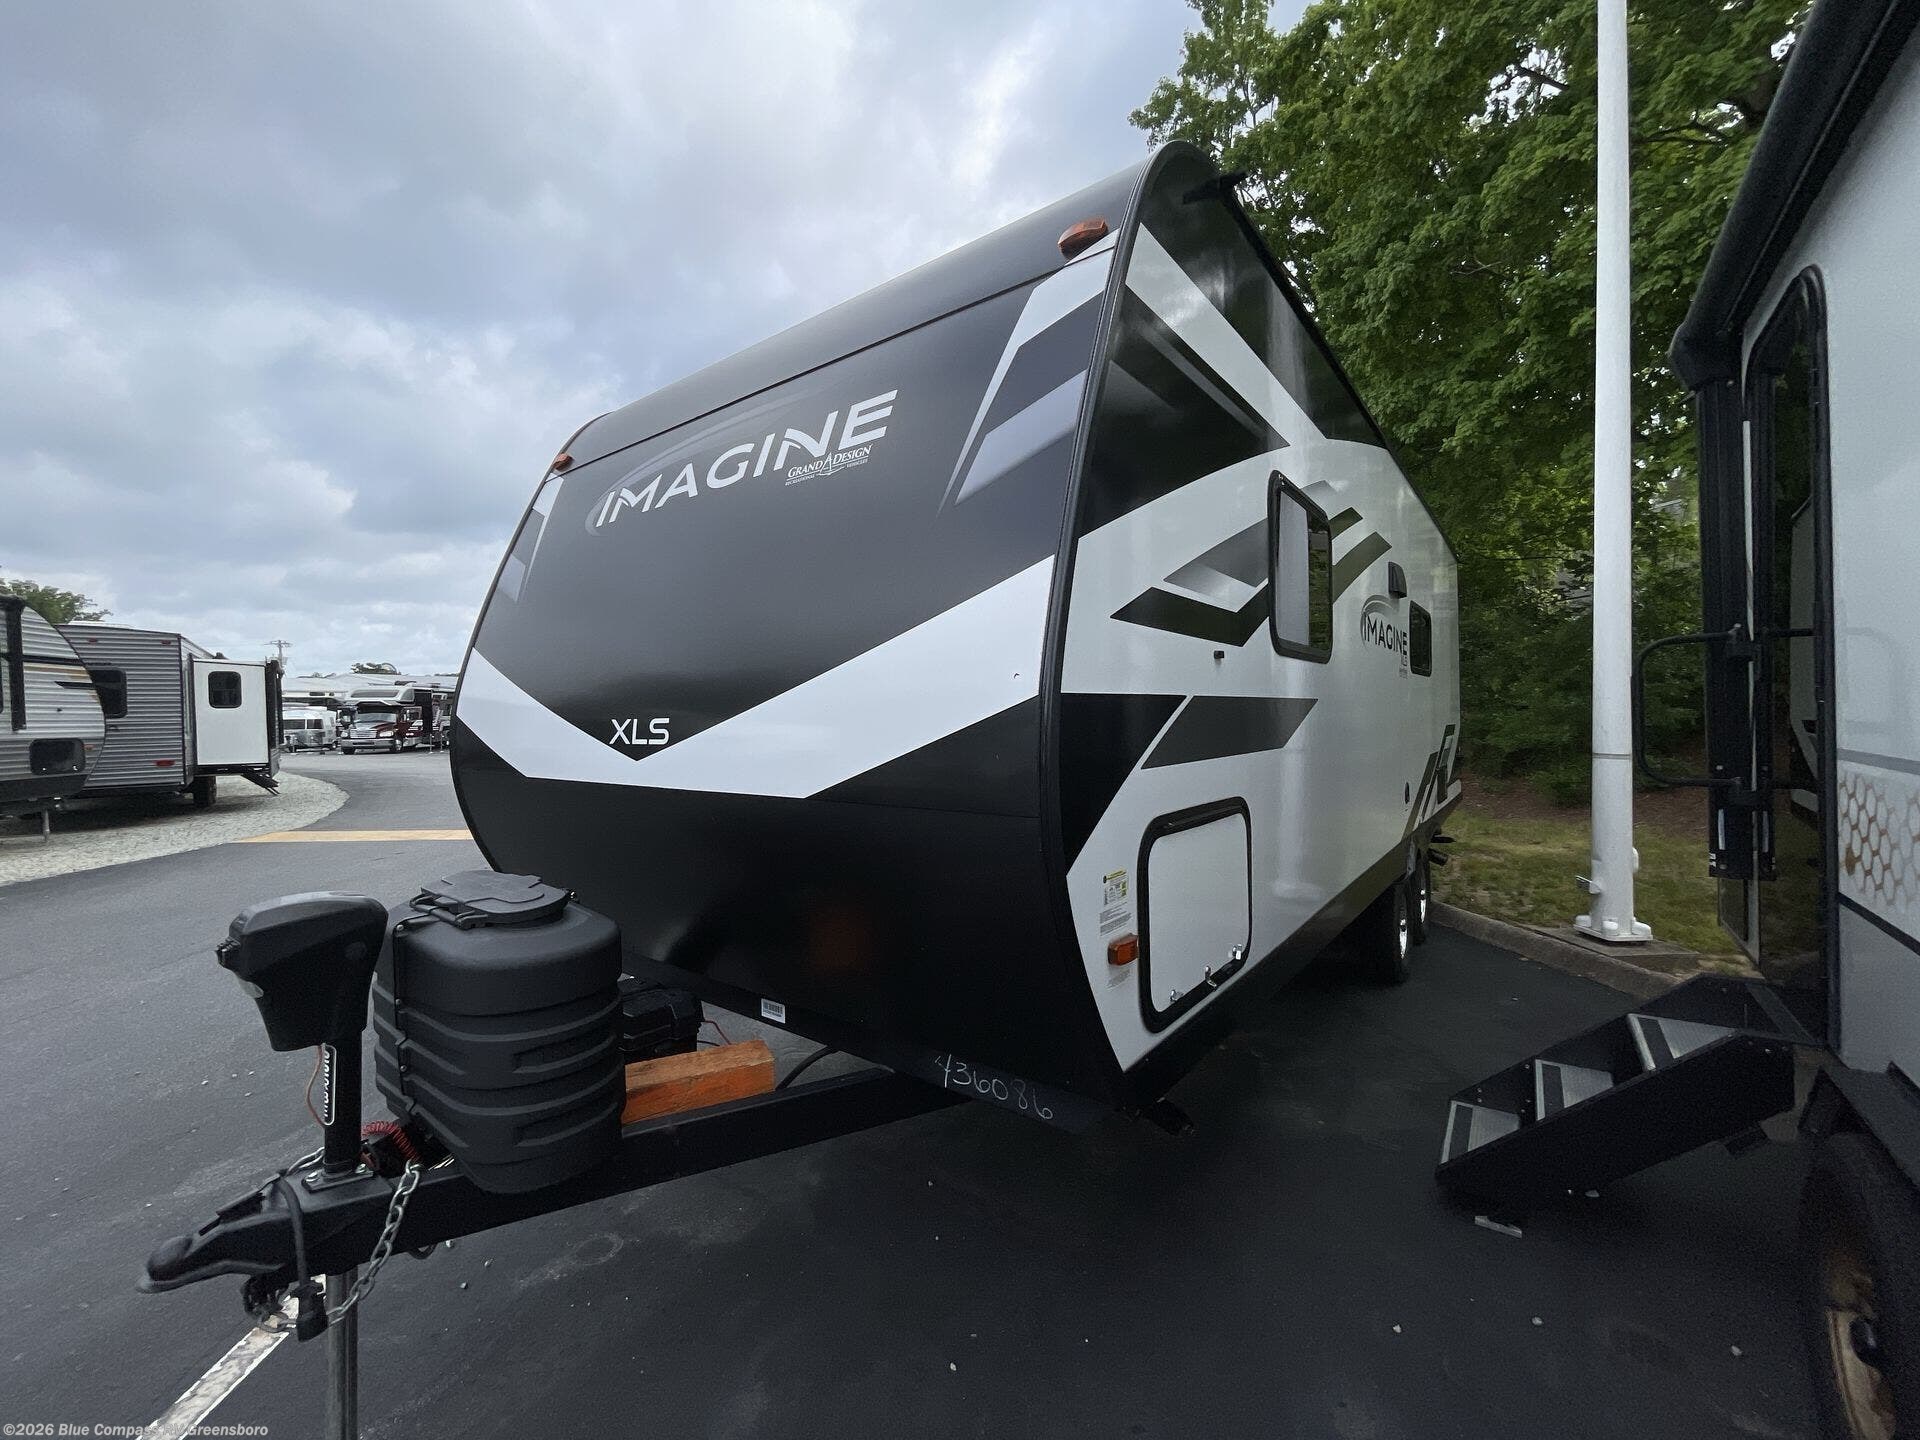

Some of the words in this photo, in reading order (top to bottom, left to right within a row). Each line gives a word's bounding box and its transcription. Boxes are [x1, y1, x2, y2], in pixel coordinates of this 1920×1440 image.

[596, 389, 898, 528] IMAGINE
[788, 460, 823, 477] GRAND
[832, 443, 874, 465] DESIGN
[1364, 611, 1408, 655] IMAGINE
[609, 717, 670, 745] XLS
[935, 1054, 1053, 1119] 436086
